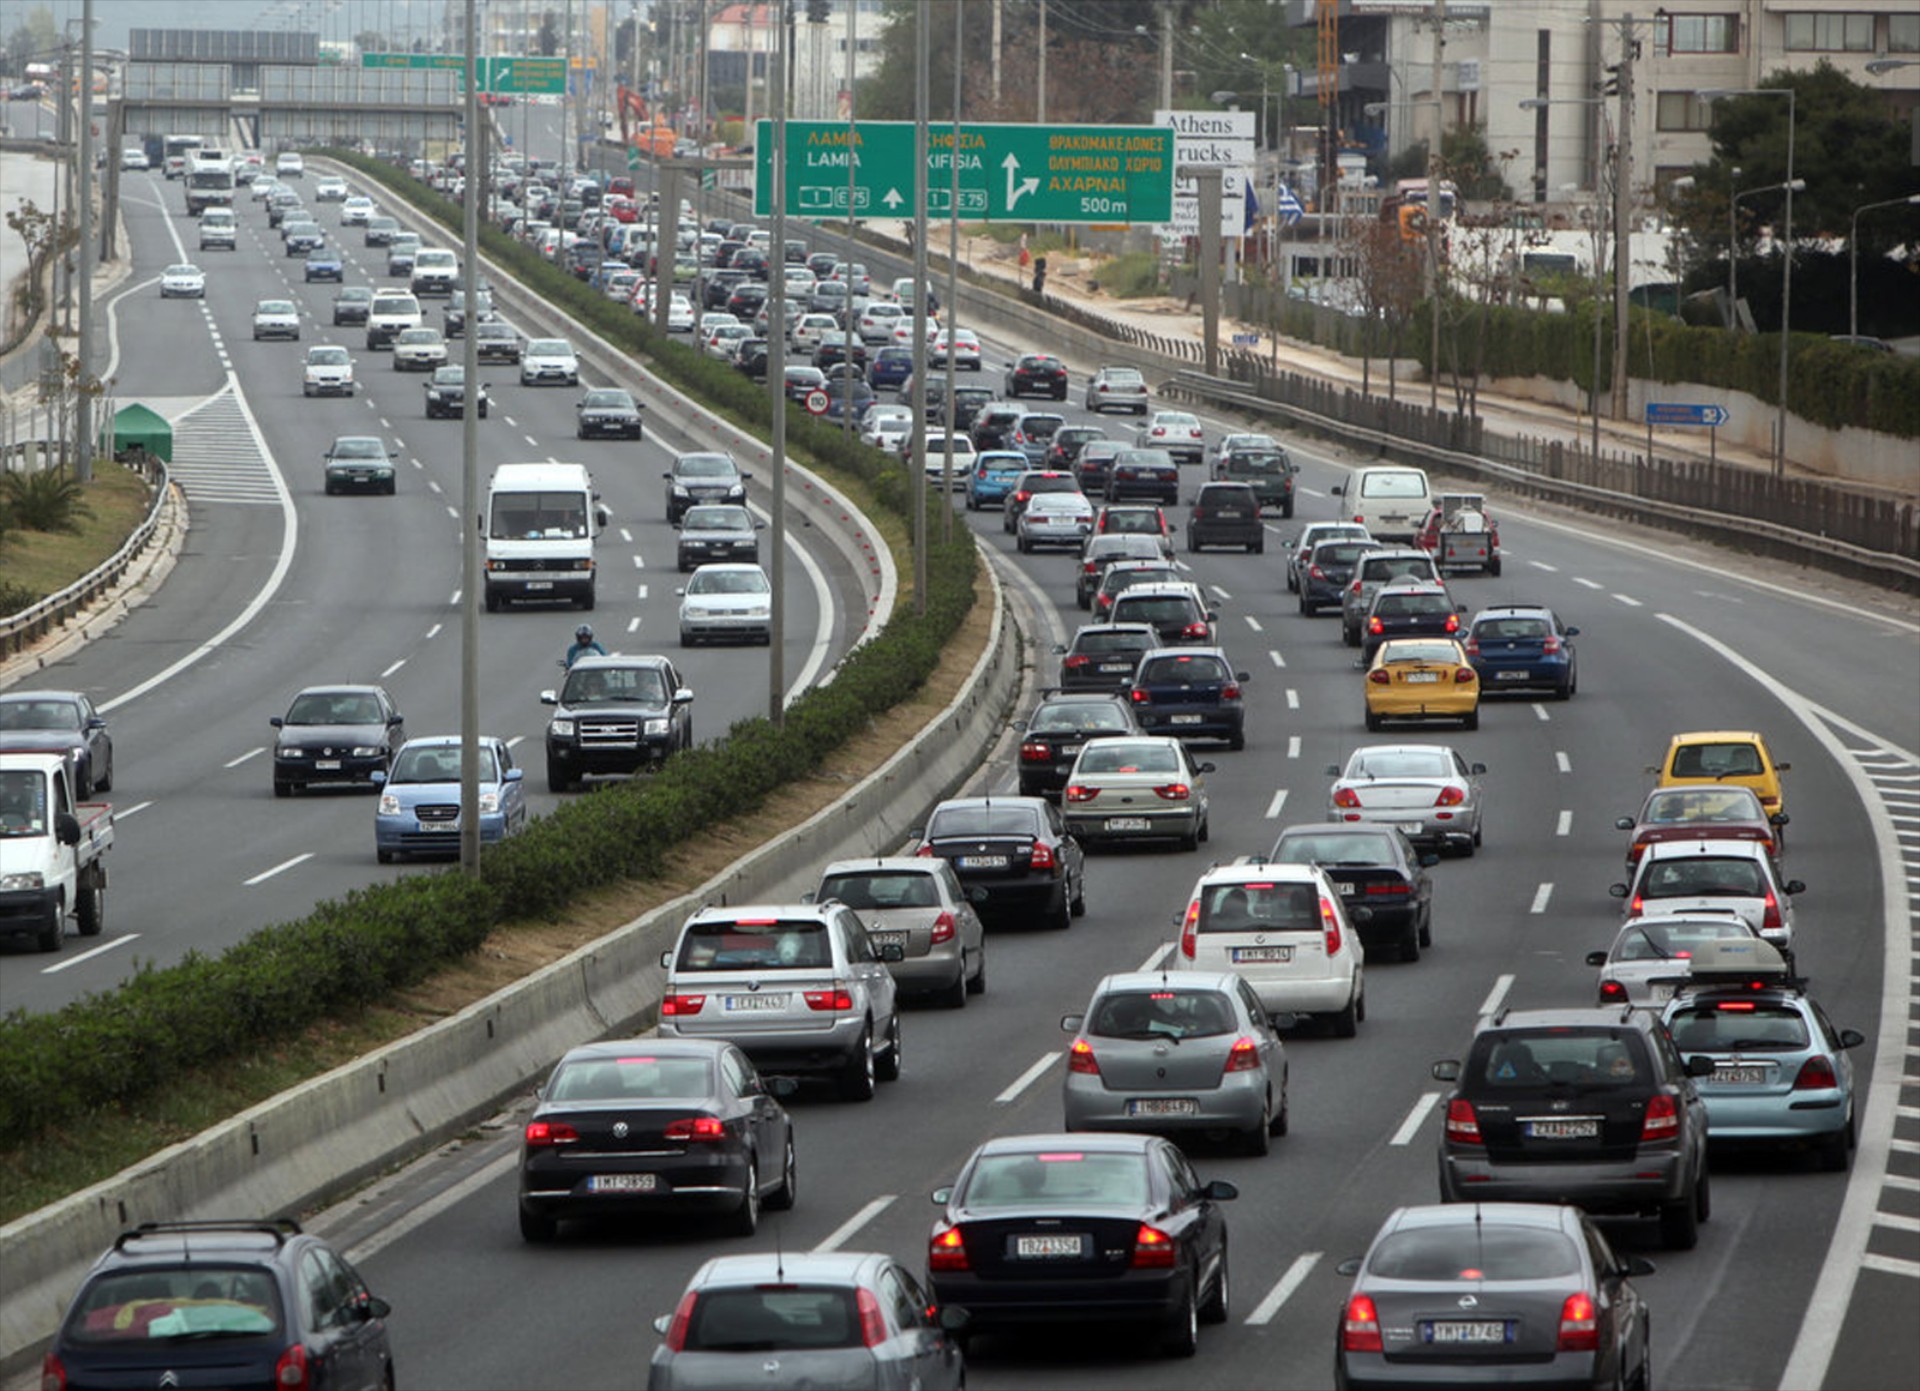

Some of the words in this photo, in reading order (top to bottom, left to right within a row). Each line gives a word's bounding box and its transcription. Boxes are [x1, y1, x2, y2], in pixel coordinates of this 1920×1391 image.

[1168, 114, 1233, 134] Athens
[807, 151, 862, 167] LAMIA
[1178, 144, 1232, 162] rucks
